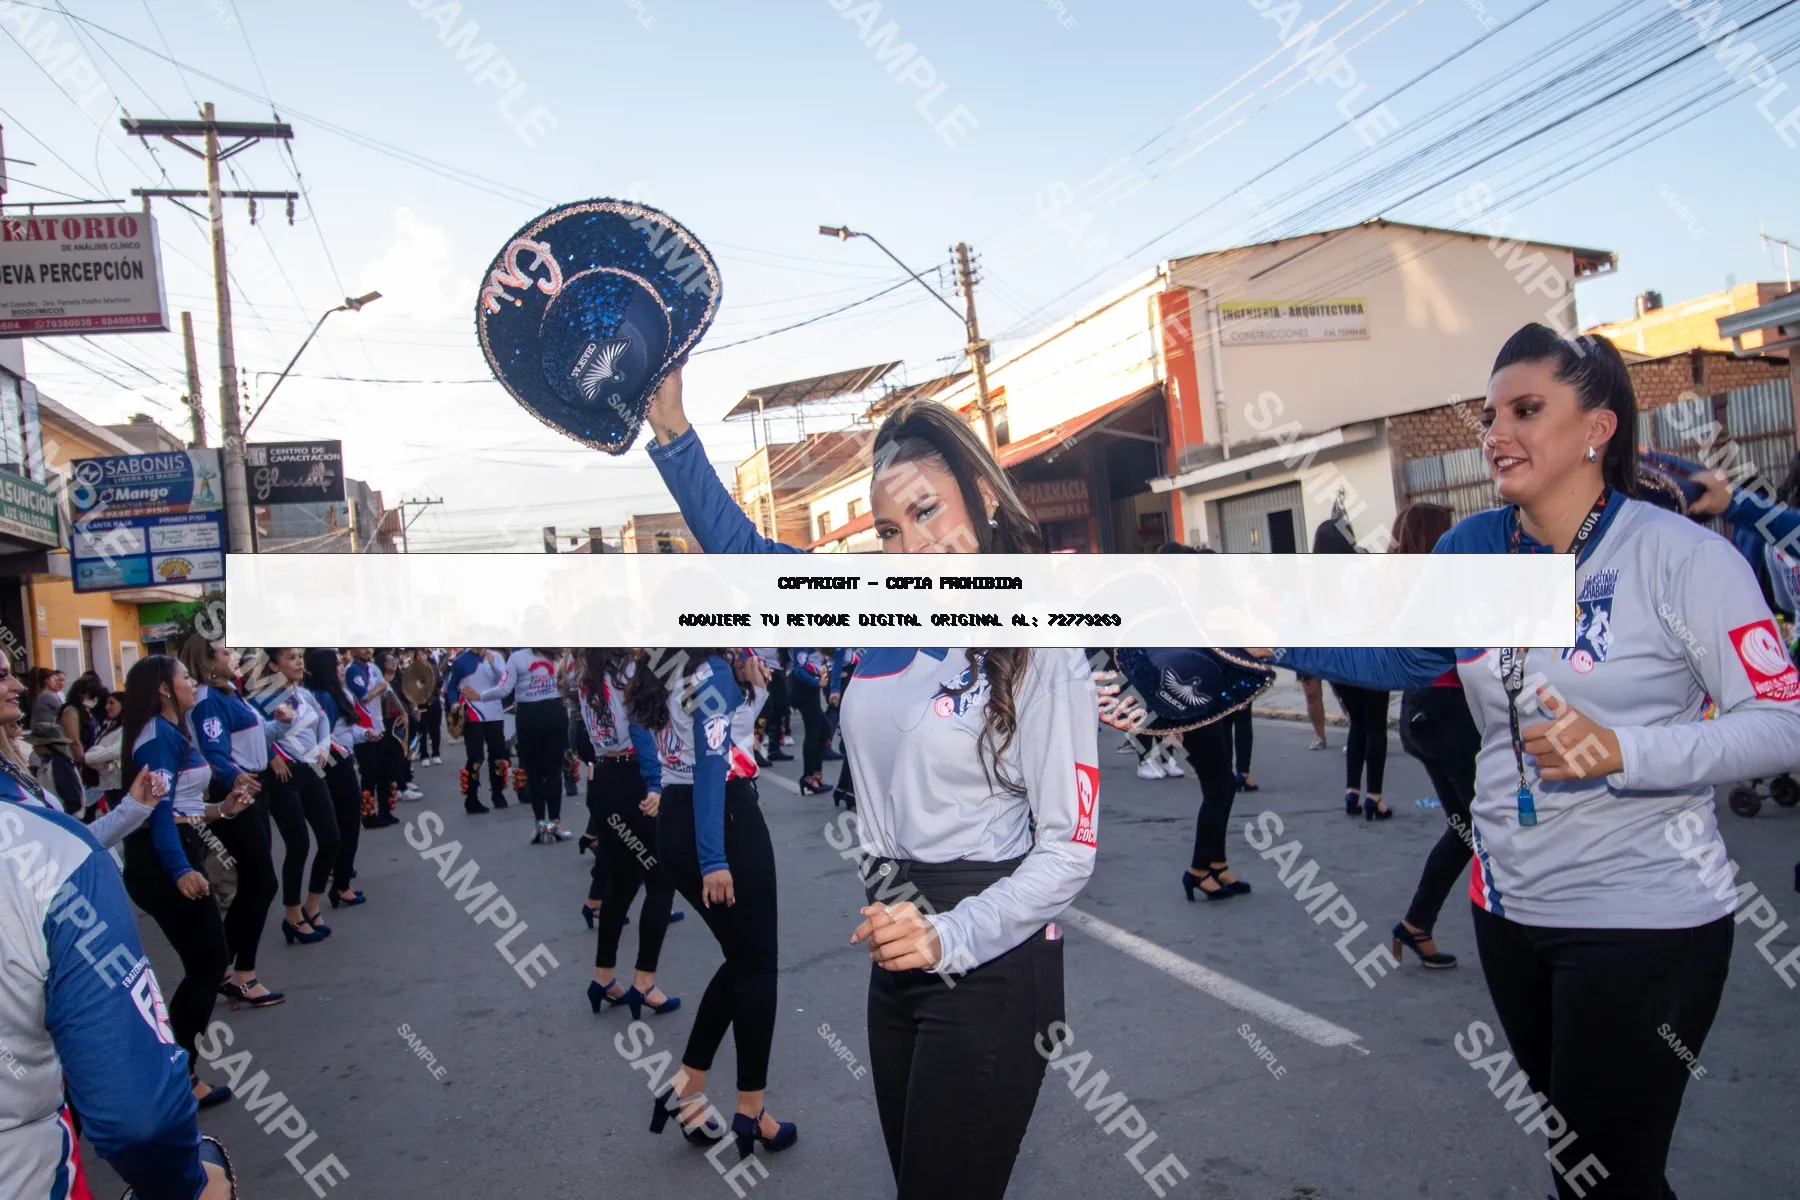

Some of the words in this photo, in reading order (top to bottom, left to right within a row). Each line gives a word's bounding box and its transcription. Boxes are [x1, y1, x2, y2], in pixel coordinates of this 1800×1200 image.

[74, 242, 108, 251] ANÁLISIS
[110, 241, 141, 250] CLÍNICO
[0, 264, 35, 285] EVA
[39, 256, 144, 283] PERCEPCIÓN
[1288, 304, 1364, 319] ARQUITECTURA
[1231, 328, 1309, 341] CONSTRUCCIONES
[270, 447, 309, 456] CENTRO
[311, 446, 325, 454] DE
[270, 453, 340, 463] CAPACITACIÓN
[105, 455, 185, 475] SABONIS
[114, 476, 142, 484] LIBERA
[116, 486, 169, 502] Mango
[1030, 479, 1089, 505] FARMACIA
[4, 505, 18, 520] LUZ
[106, 510, 131, 518] PASE
[147, 507, 169, 515] PISO
[159, 516, 187, 525] PRIMER
[1578, 510, 1601, 541] GUIA
[1513, 659, 1522, 689] GUIA
